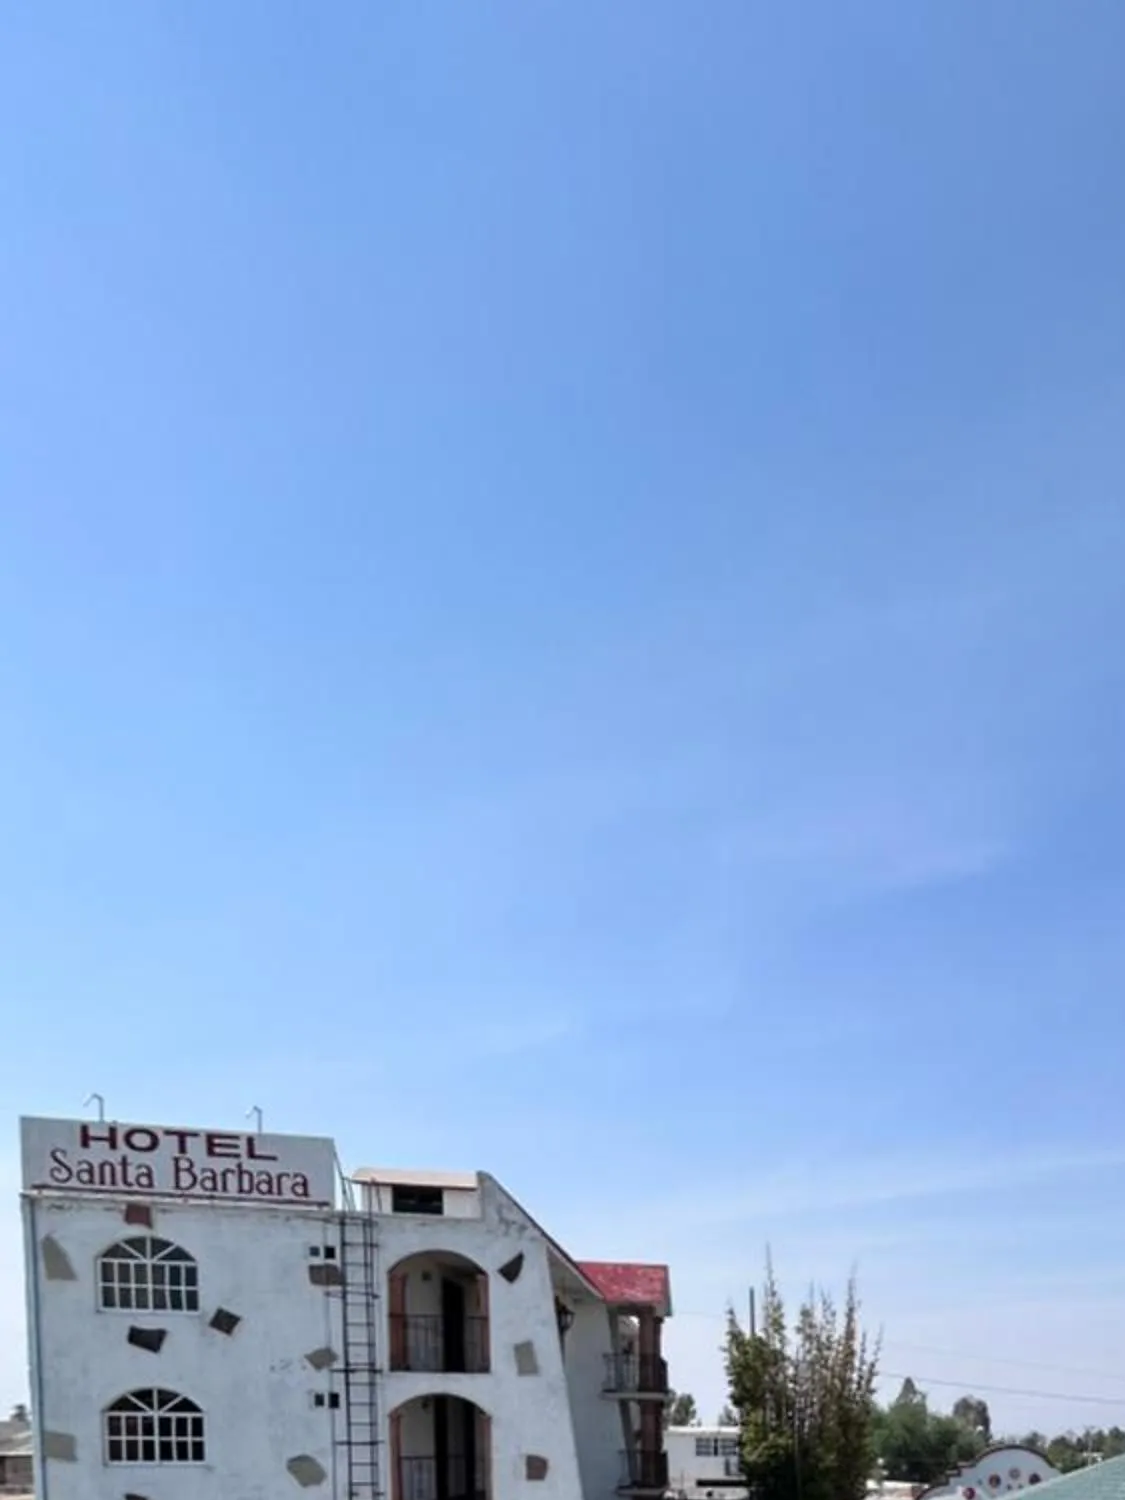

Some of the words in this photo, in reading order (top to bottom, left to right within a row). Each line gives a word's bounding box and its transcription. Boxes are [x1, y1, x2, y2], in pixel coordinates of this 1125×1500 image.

[79, 1124, 279, 1161] HOTEL
[49, 1147, 155, 1188] Santa
[172, 1155, 311, 1198] Barbara
